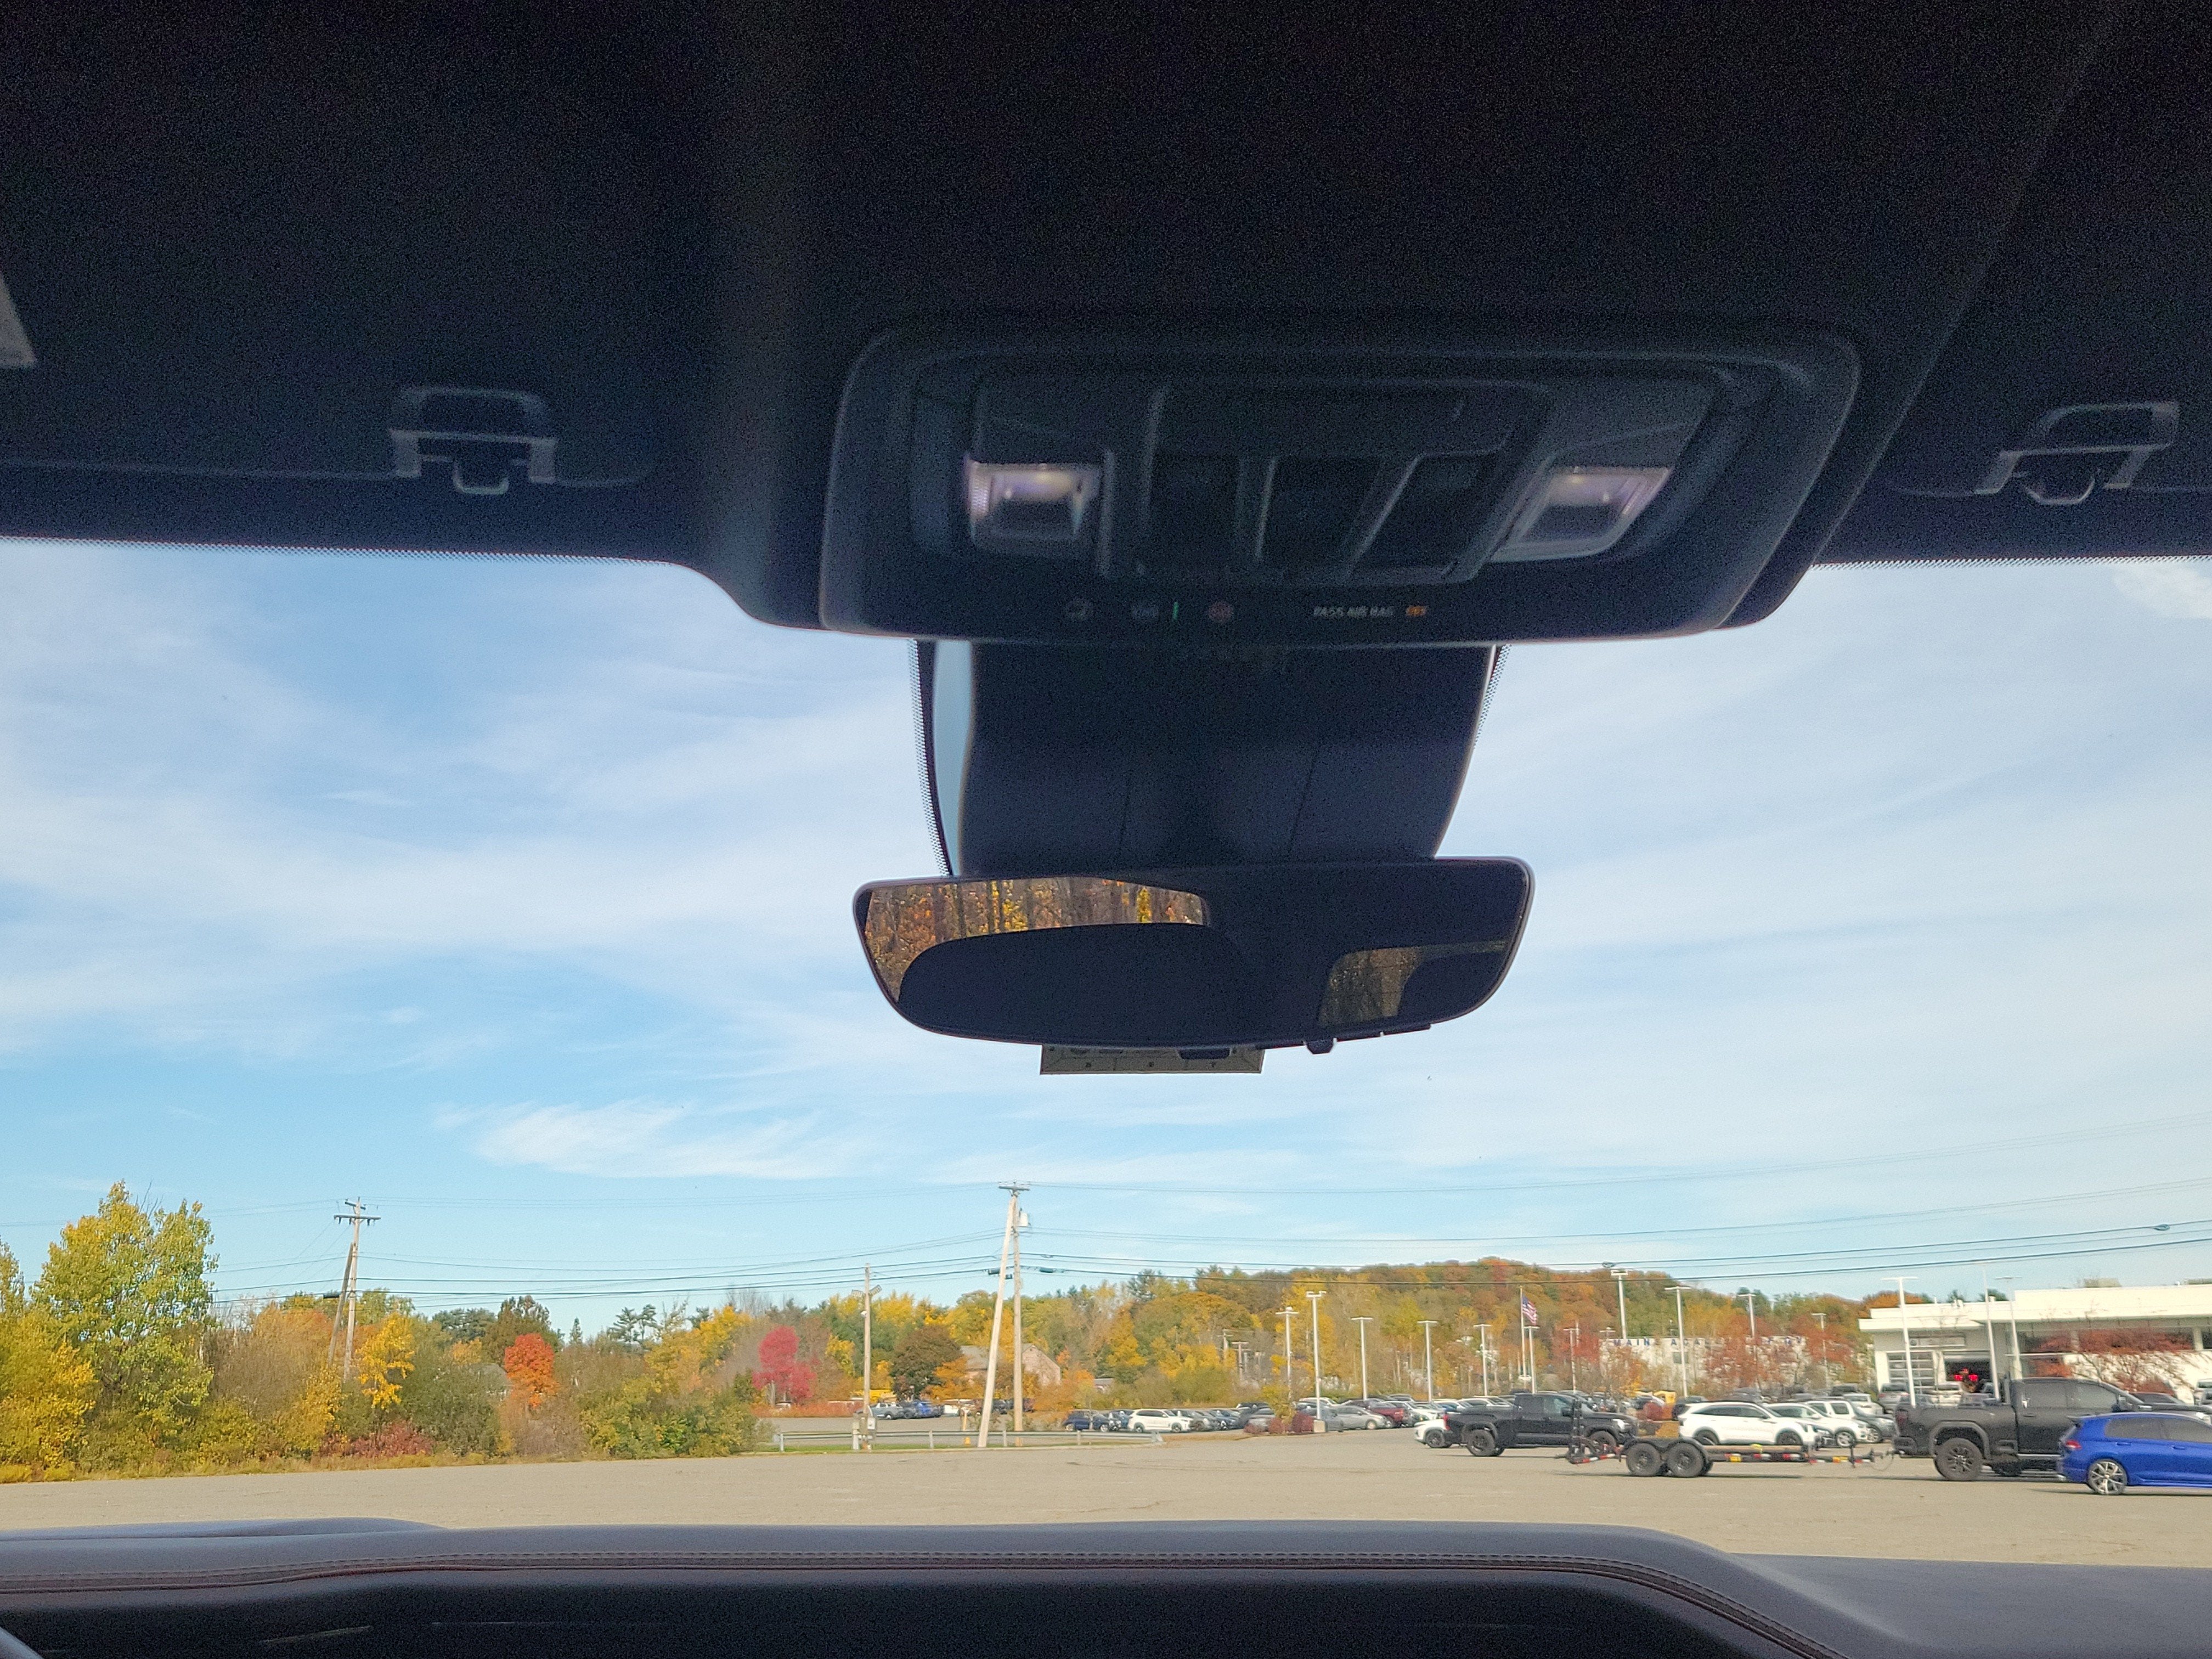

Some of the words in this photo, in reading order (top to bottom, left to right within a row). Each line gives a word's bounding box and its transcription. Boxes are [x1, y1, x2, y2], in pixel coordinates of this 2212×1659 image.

[1313, 605, 1344, 617] PASS
[1347, 605, 1368, 617] AIR
[1370, 605, 1394, 617] BAG
